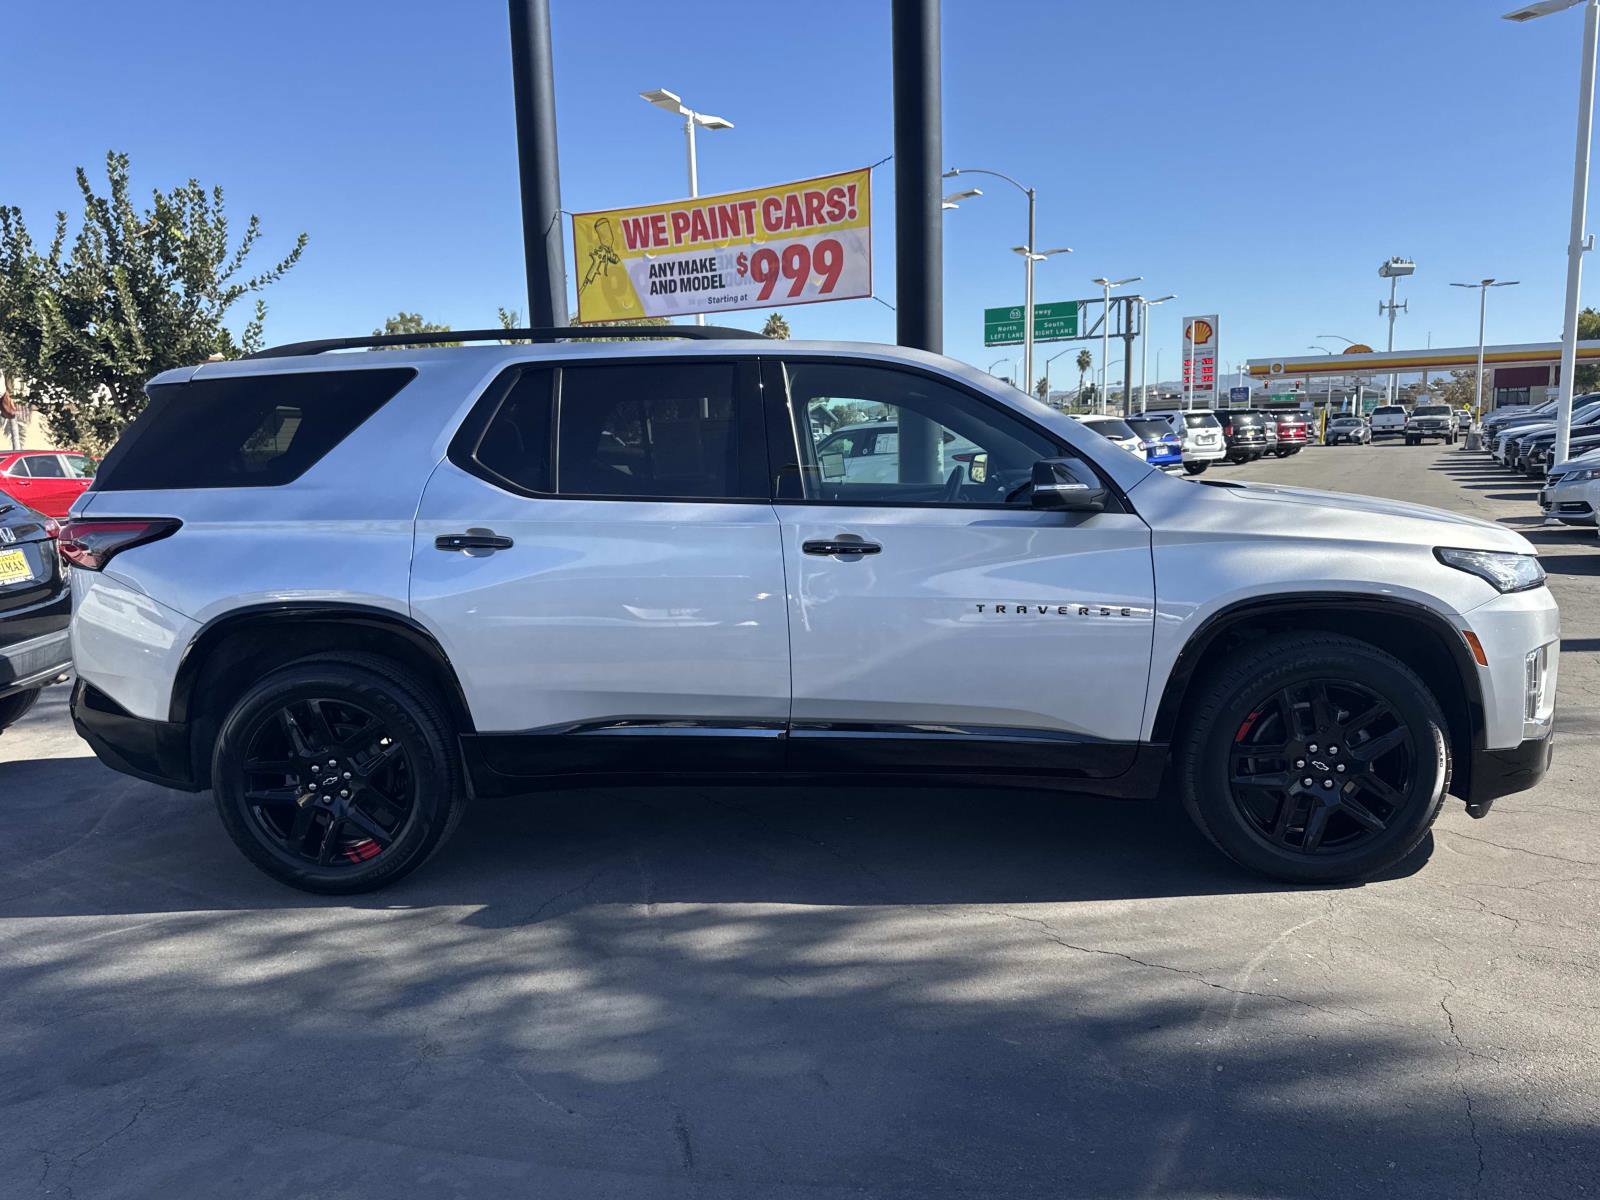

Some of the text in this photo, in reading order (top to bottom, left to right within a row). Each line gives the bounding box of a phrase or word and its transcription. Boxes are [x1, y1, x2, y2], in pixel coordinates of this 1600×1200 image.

[621, 184, 857, 250] WE PAINT CARS!
[649, 257, 717, 279] ANY MAKE
[736, 239, 844, 301] $999
[650, 274, 726, 295] AND MODEL
[707, 294, 738, 304] Starting
[976, 604, 1131, 617] TRAVERSE
